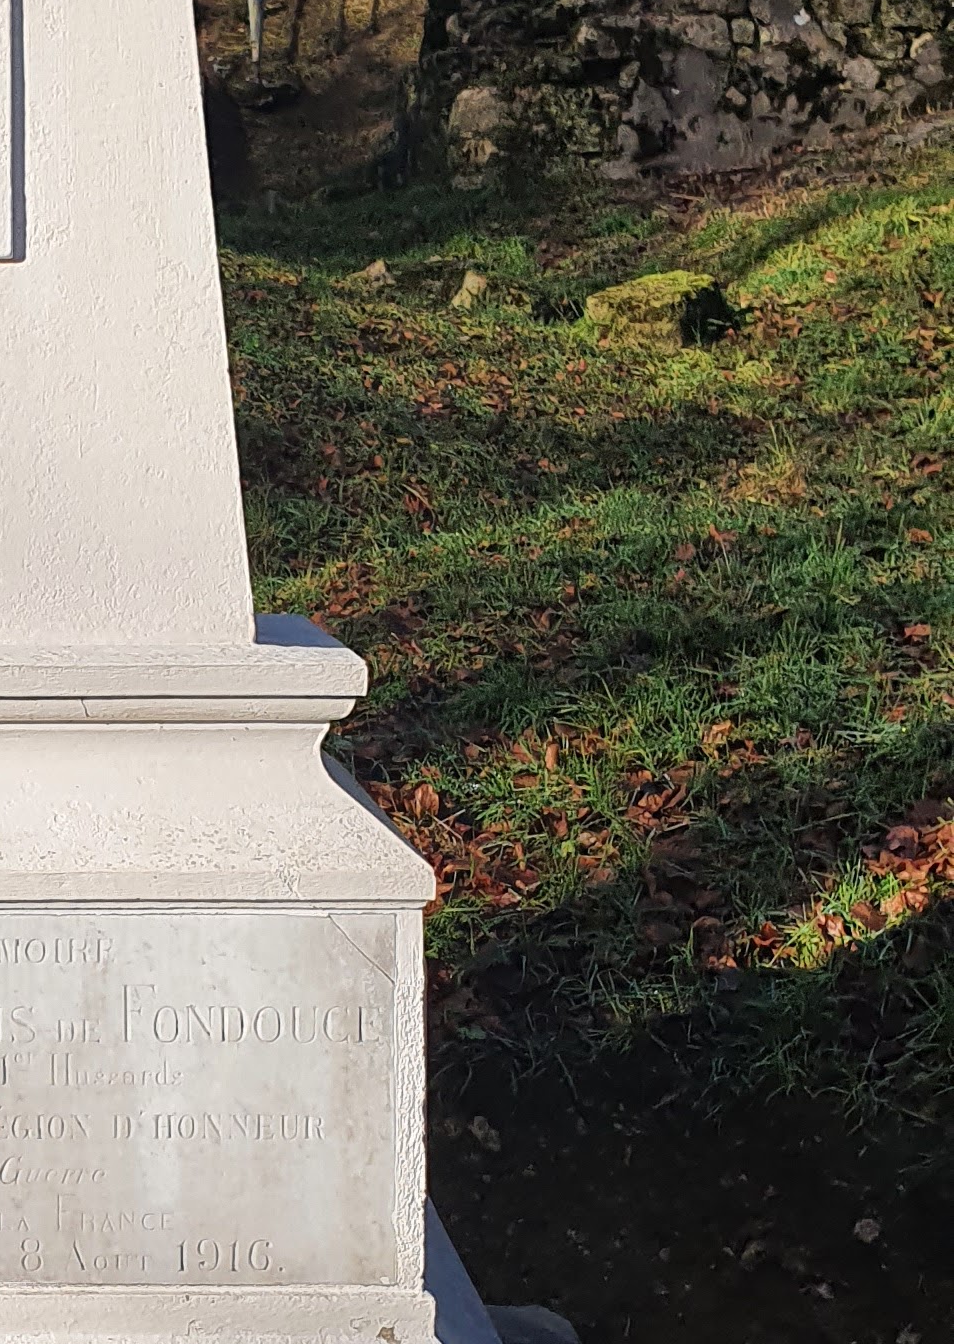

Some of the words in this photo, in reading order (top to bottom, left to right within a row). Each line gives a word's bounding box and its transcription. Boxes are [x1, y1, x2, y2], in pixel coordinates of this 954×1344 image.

[56, 1018, 102, 1045] DE
[122, 983, 384, 1046] FONDOUCE
[49, 1051, 184, 1088] Hussards
[55, 1192, 175, 1233] FRANCE
[19, 1237, 44, 1272] 8
[175, 1238, 286, 1273] 1916.
